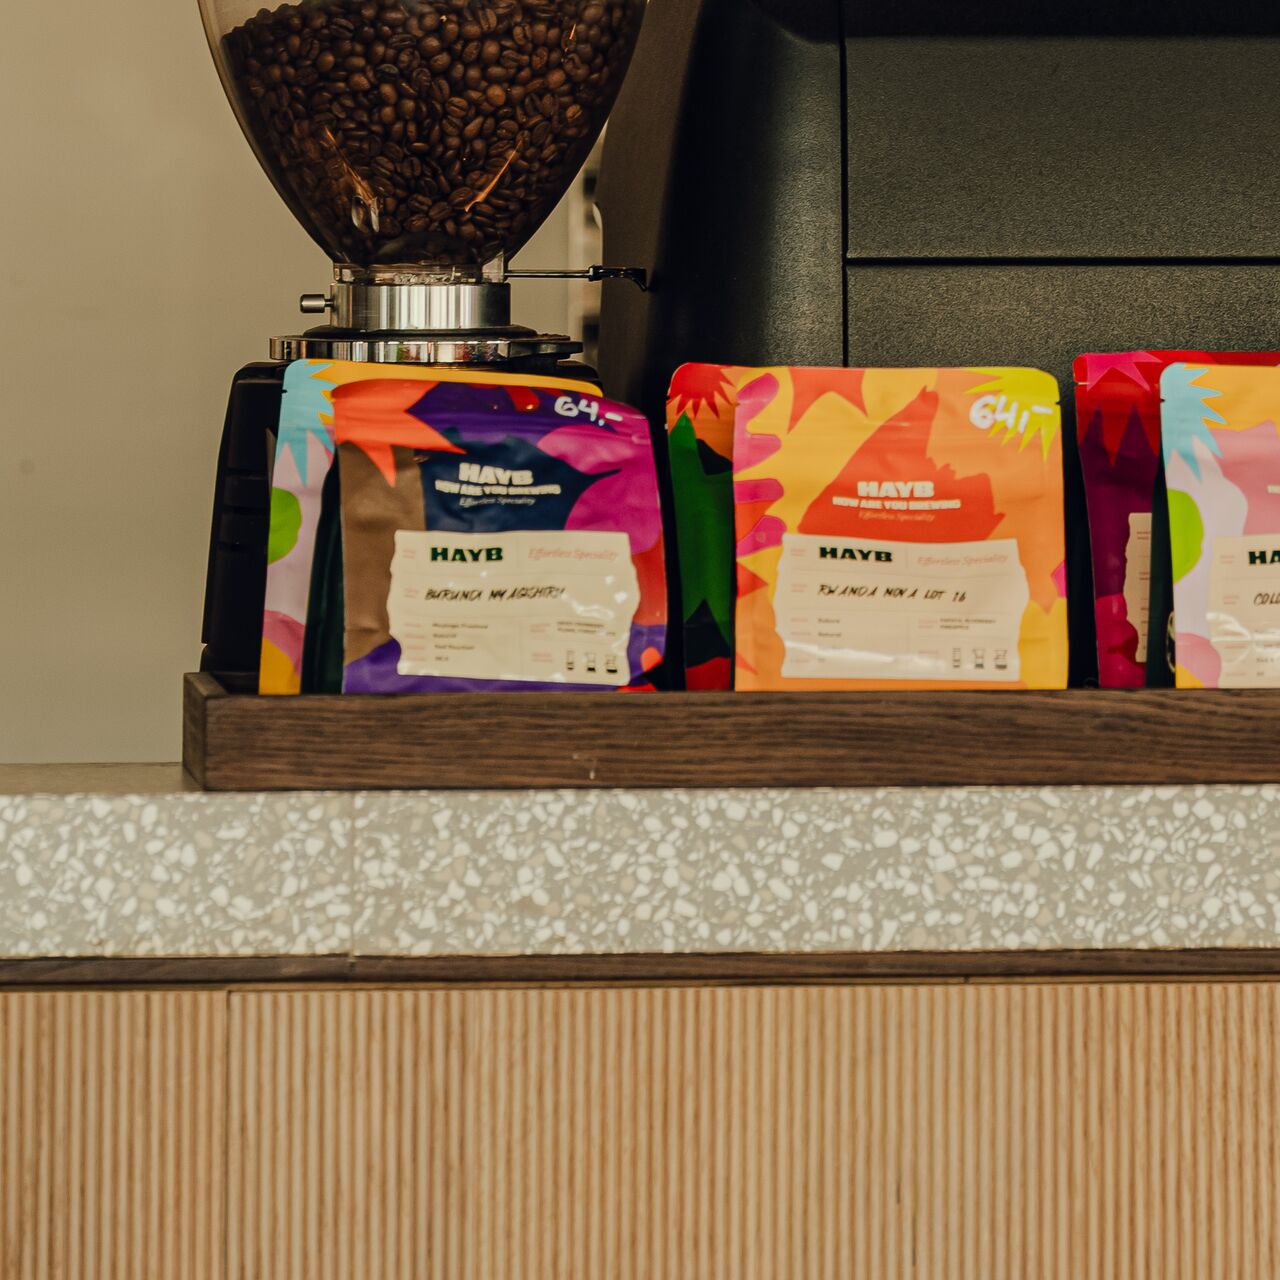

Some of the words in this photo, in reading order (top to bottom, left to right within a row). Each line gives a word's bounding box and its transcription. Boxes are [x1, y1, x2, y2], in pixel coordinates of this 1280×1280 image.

[458, 462, 534, 486] HAYB
[857, 480, 935, 498] HAYB
[430, 546, 504, 563] HAYB
[818, 546, 894, 563] HAYB
